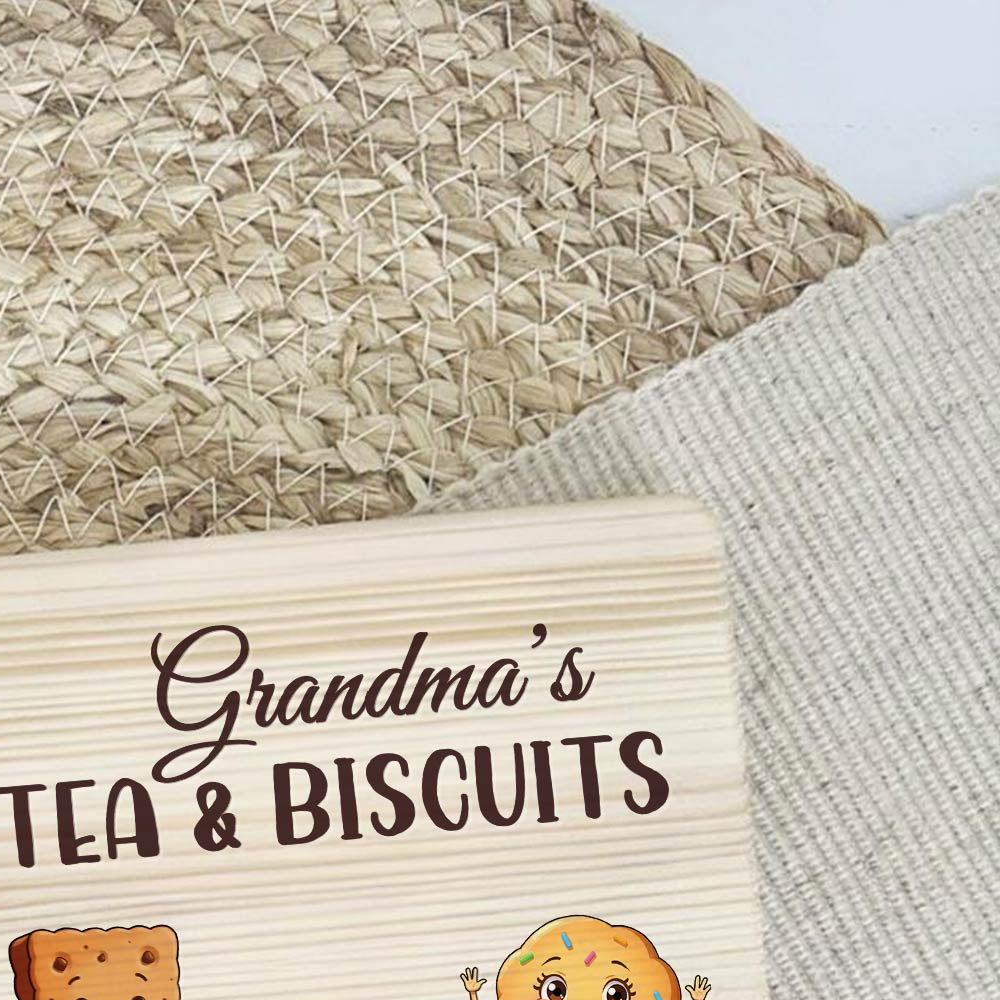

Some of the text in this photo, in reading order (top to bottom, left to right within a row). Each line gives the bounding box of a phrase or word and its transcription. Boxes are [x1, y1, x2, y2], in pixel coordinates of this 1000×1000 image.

[150, 623, 597, 784] Grandma's
[193, 781, 242, 852] &
[272, 730, 671, 846] BISCUITS
